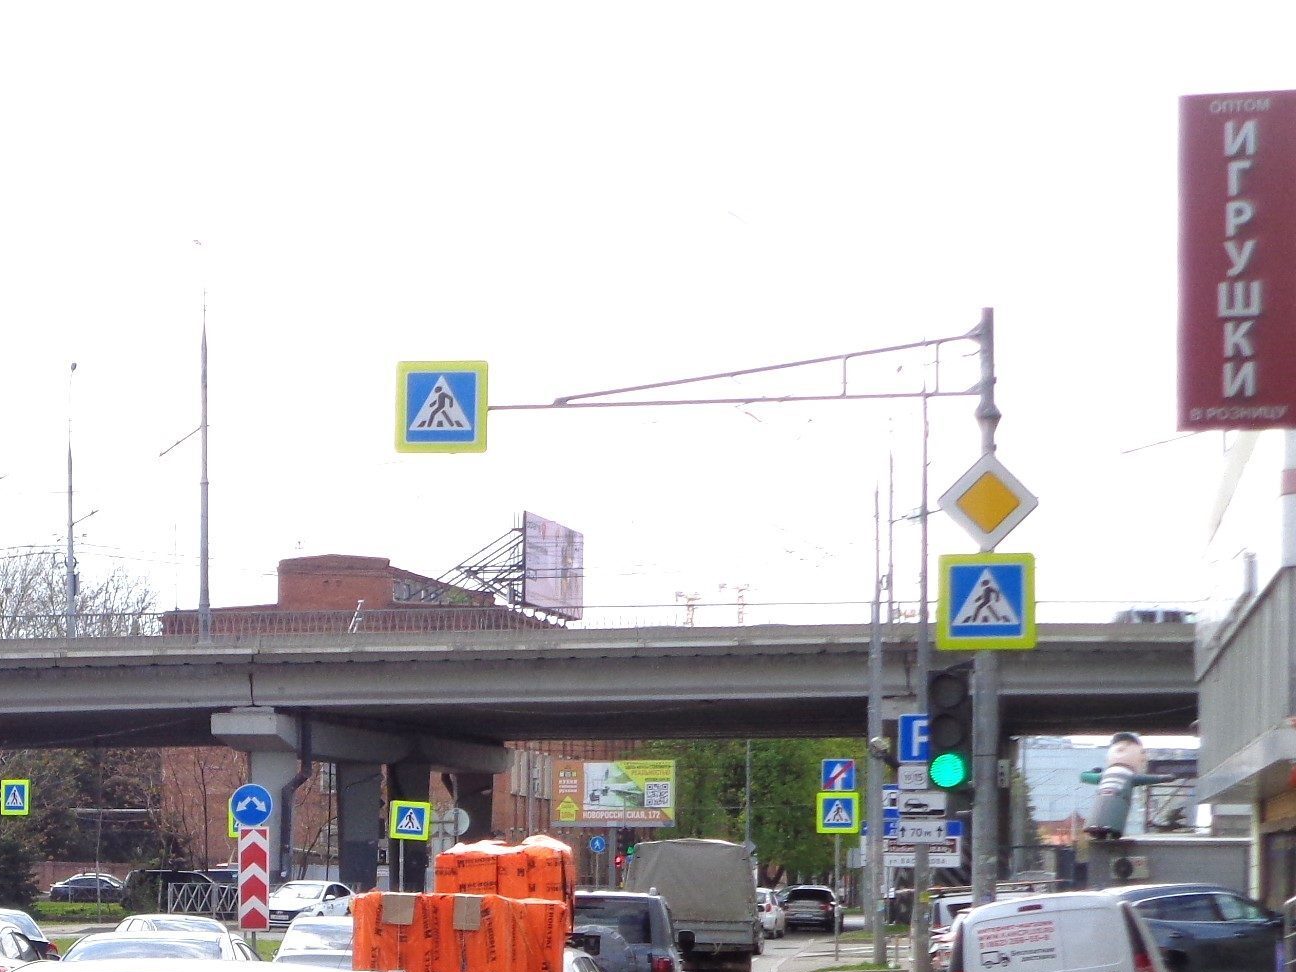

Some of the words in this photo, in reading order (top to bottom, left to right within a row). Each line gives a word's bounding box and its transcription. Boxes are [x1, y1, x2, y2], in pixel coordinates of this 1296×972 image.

[1217, 119, 1264, 399] ИГРУШКИ
[582, 810, 647, 820] НОВОРОССИСКАЯ,
[648, 810, 661, 819] 172
[910, 828, 923, 838] 70
